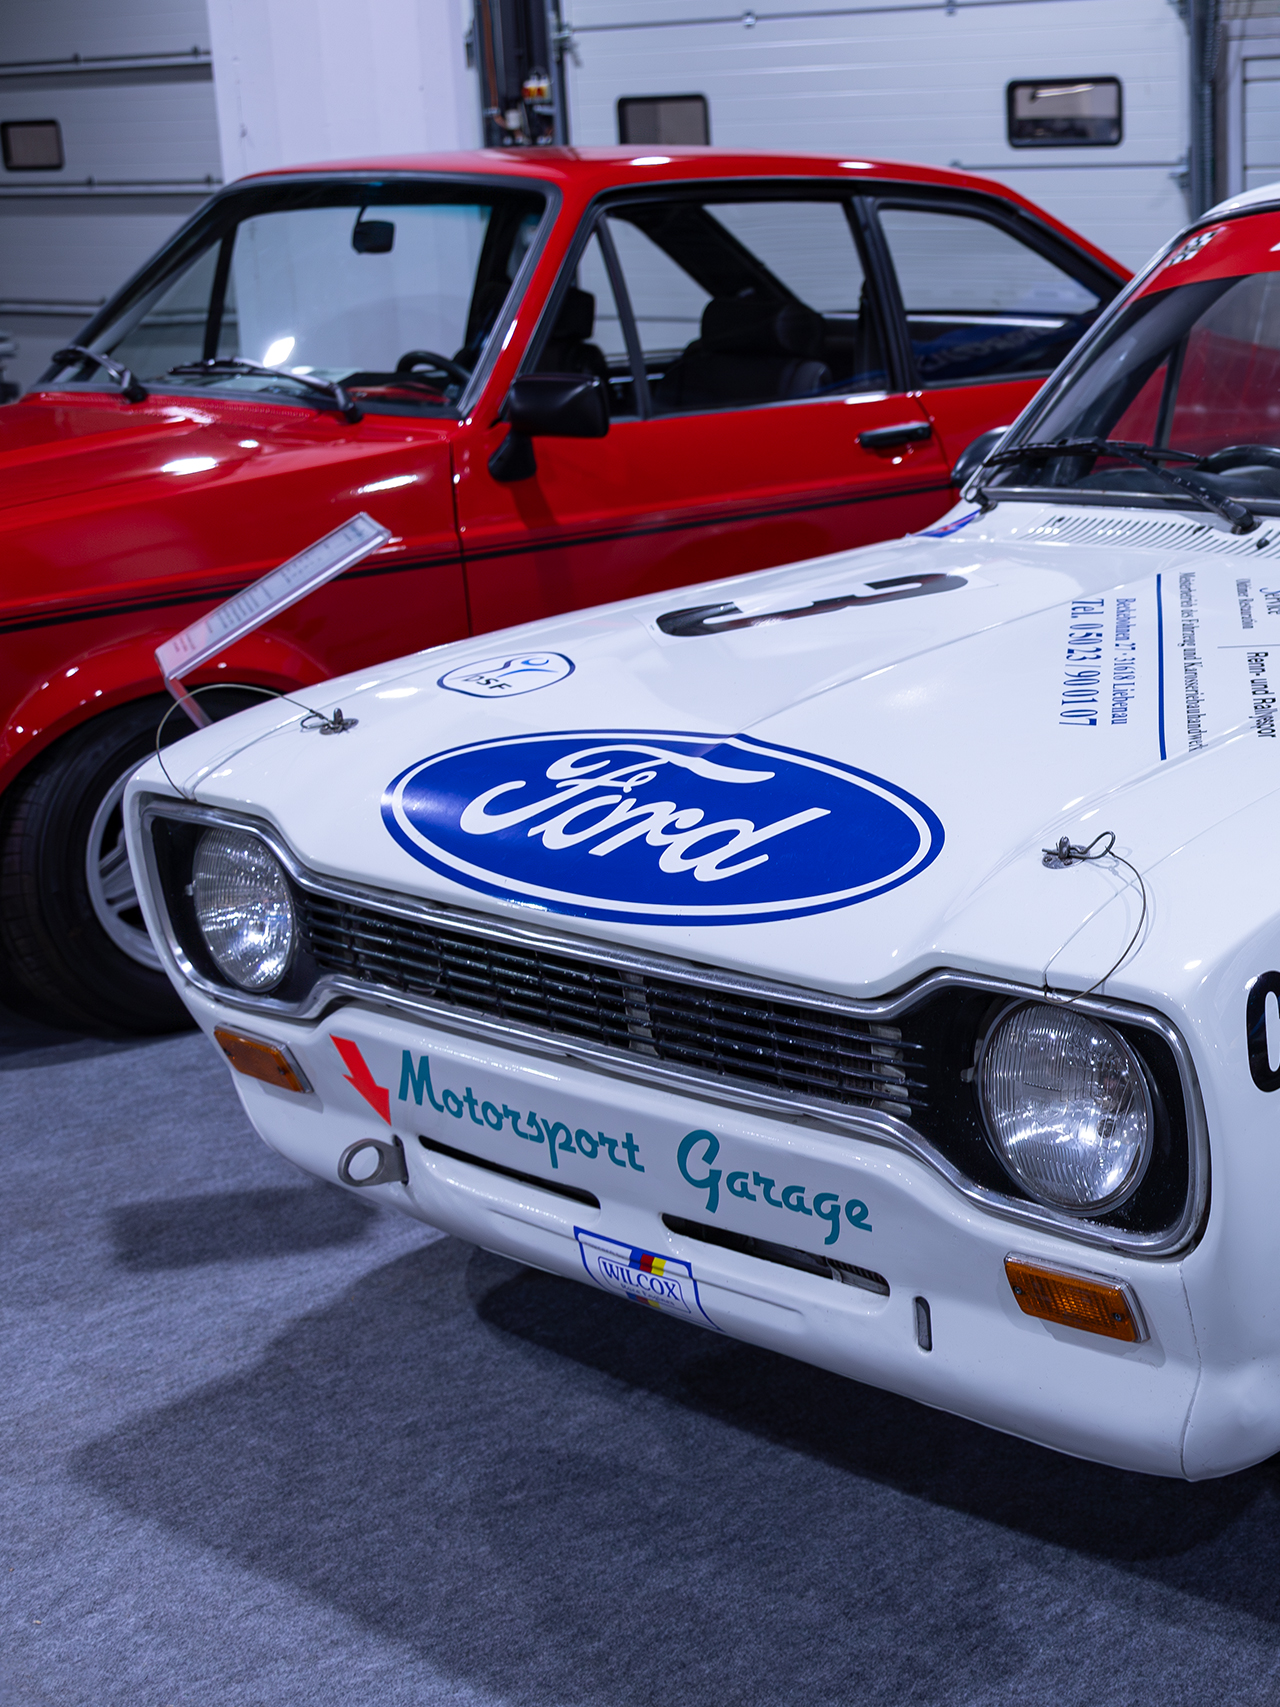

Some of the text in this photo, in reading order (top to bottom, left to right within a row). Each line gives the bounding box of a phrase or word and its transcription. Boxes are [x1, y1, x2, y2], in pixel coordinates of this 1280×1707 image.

[1070, 598, 1105, 619] Tel.
[1180, 609, 1199, 618] des
[1177, 618, 1200, 648] Fahrzeug
[1114, 642, 1136, 651] 27
[1183, 648, 1203, 660] und
[1113, 657, 1136, 681] 31618
[1246, 652, 1269, 676] Renn-
[1250, 678, 1276, 696] und
[1111, 681, 1135, 725] Liebenau
[1183, 661, 1209, 753] Karosseriebauhandwerk
[459, 743, 833, 883] Ford
[398, 1049, 873, 1245] Motorsport Garage
[601, 1260, 681, 1302] WILCOX
